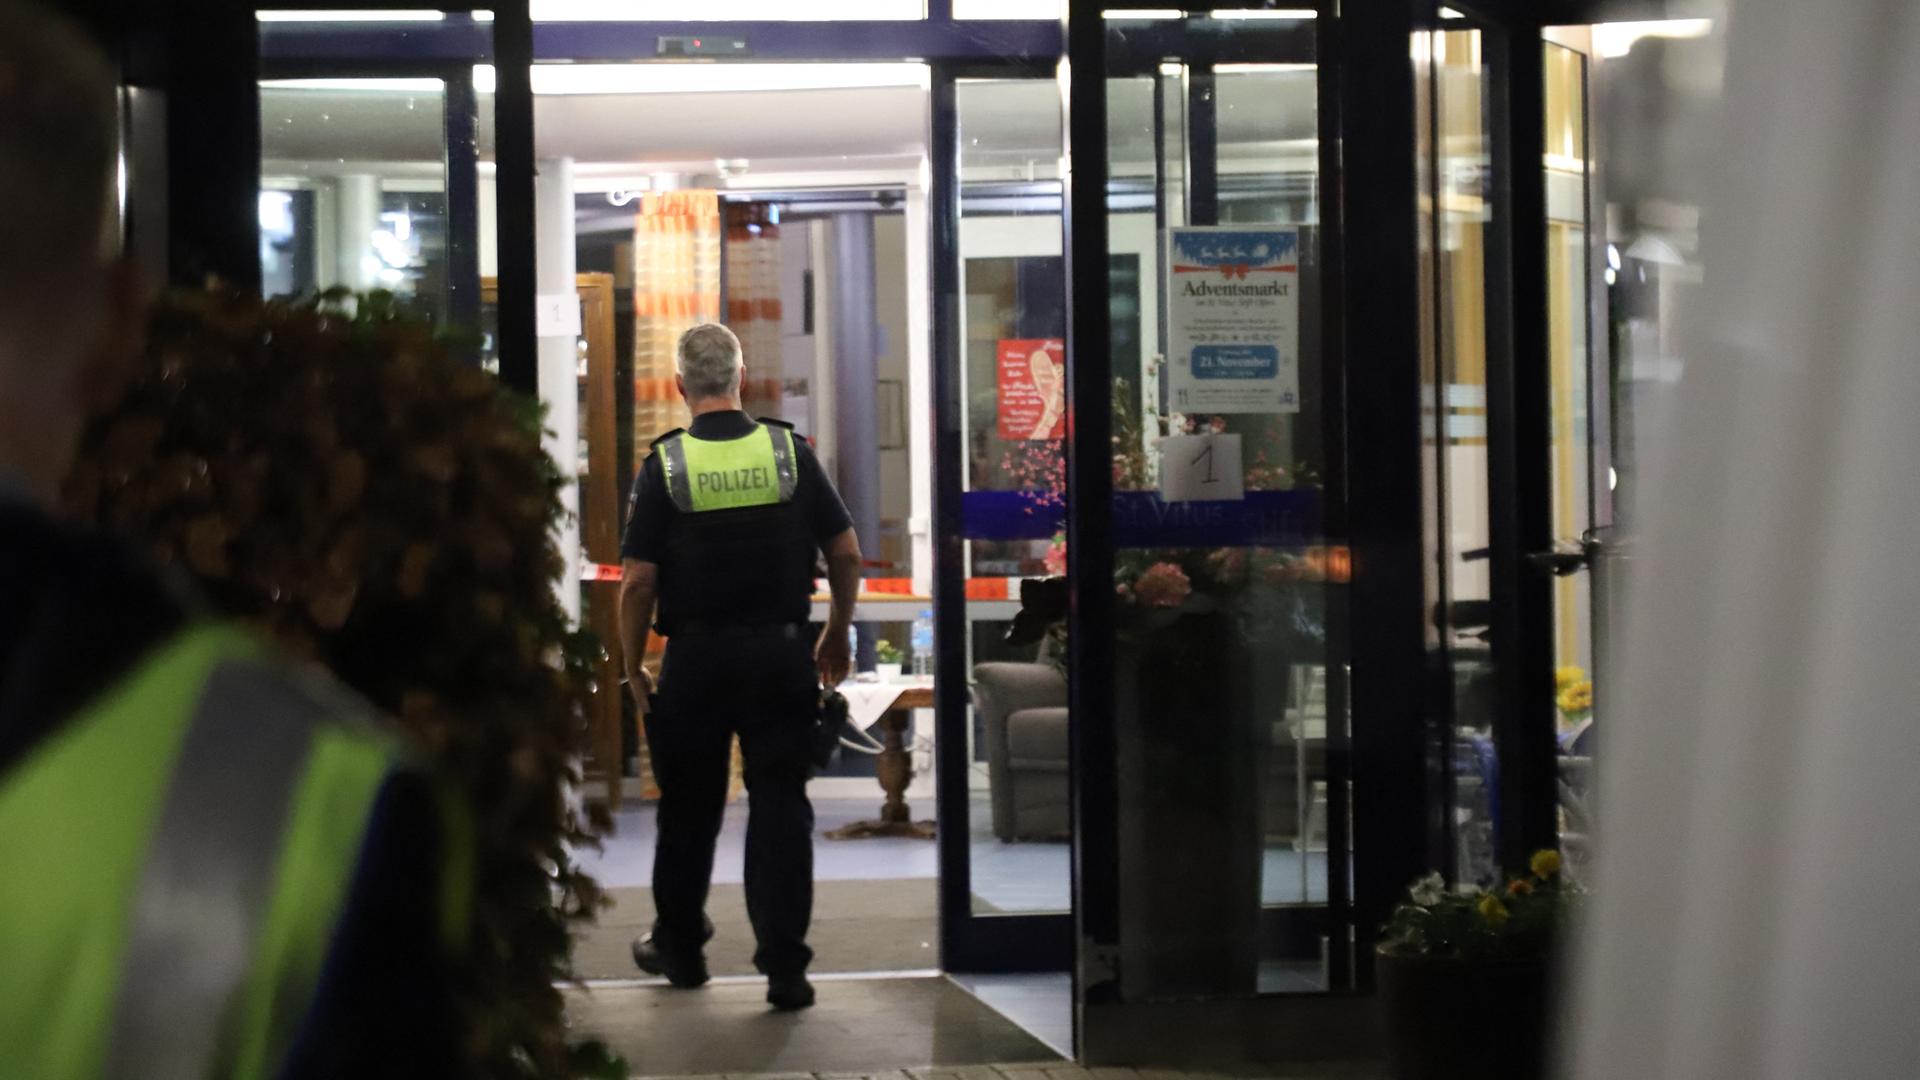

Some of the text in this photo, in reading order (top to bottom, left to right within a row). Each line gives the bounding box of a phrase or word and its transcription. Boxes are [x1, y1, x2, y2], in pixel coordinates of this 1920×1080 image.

[1182, 280, 1288, 297] Adventsmarkt
[1199, 356, 1272, 368] 21. November
[1191, 444, 1221, 484] 1
[697, 467, 769, 494] POLIZEI
